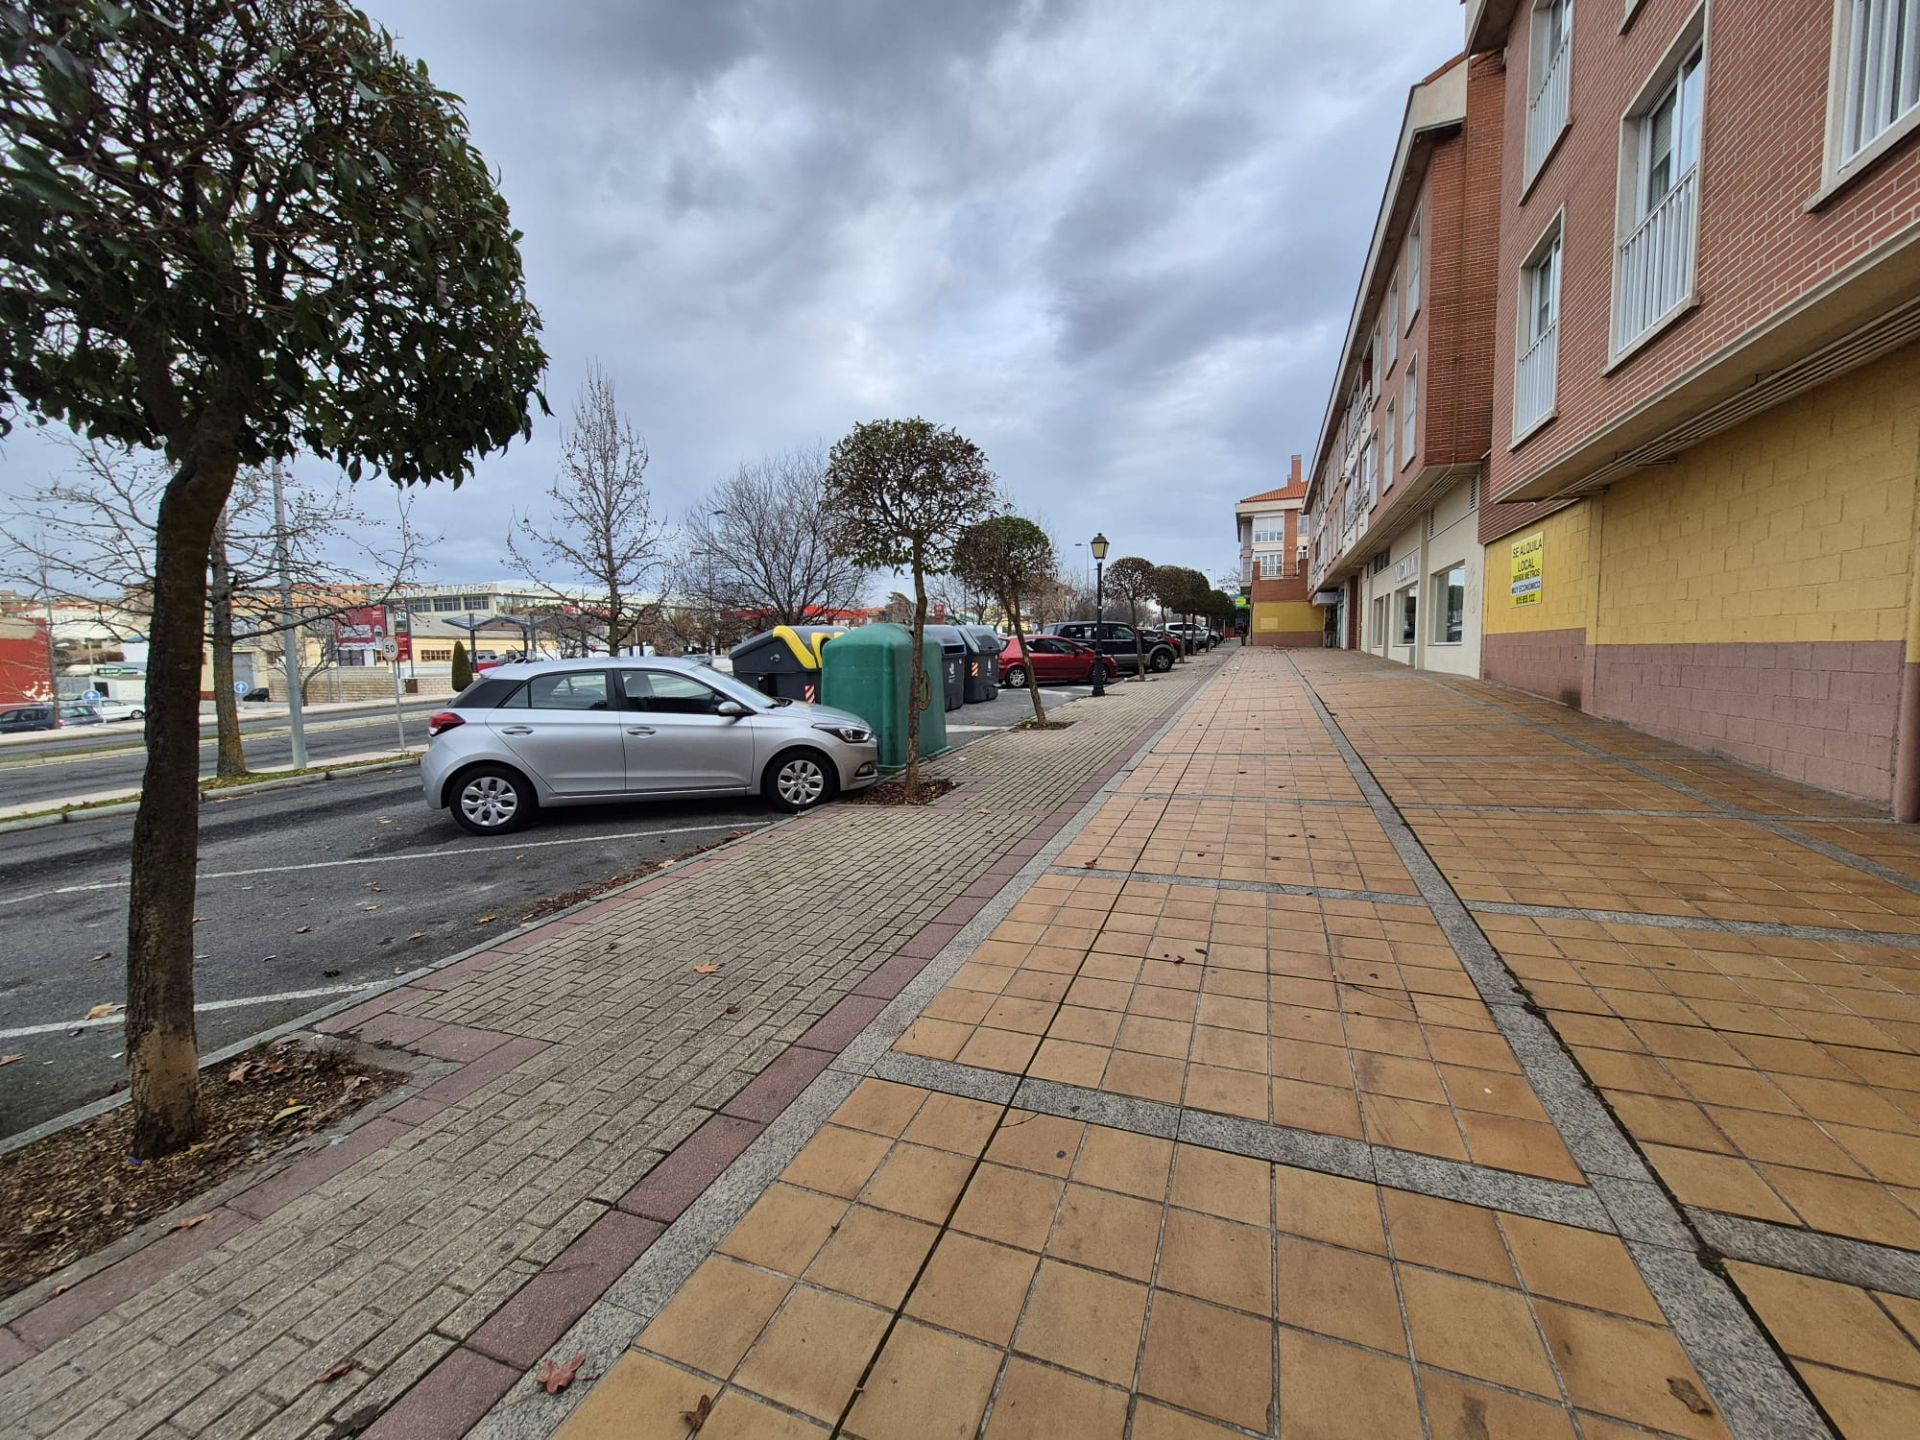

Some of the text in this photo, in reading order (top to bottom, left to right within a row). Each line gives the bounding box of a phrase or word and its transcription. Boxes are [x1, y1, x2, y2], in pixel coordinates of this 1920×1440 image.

[1513, 538, 1542, 558] SE ALQUILA
[1518, 558, 1535, 572] LOCAL
[1524, 568, 1540, 580] METROS
[385, 645, 395, 653] 50
